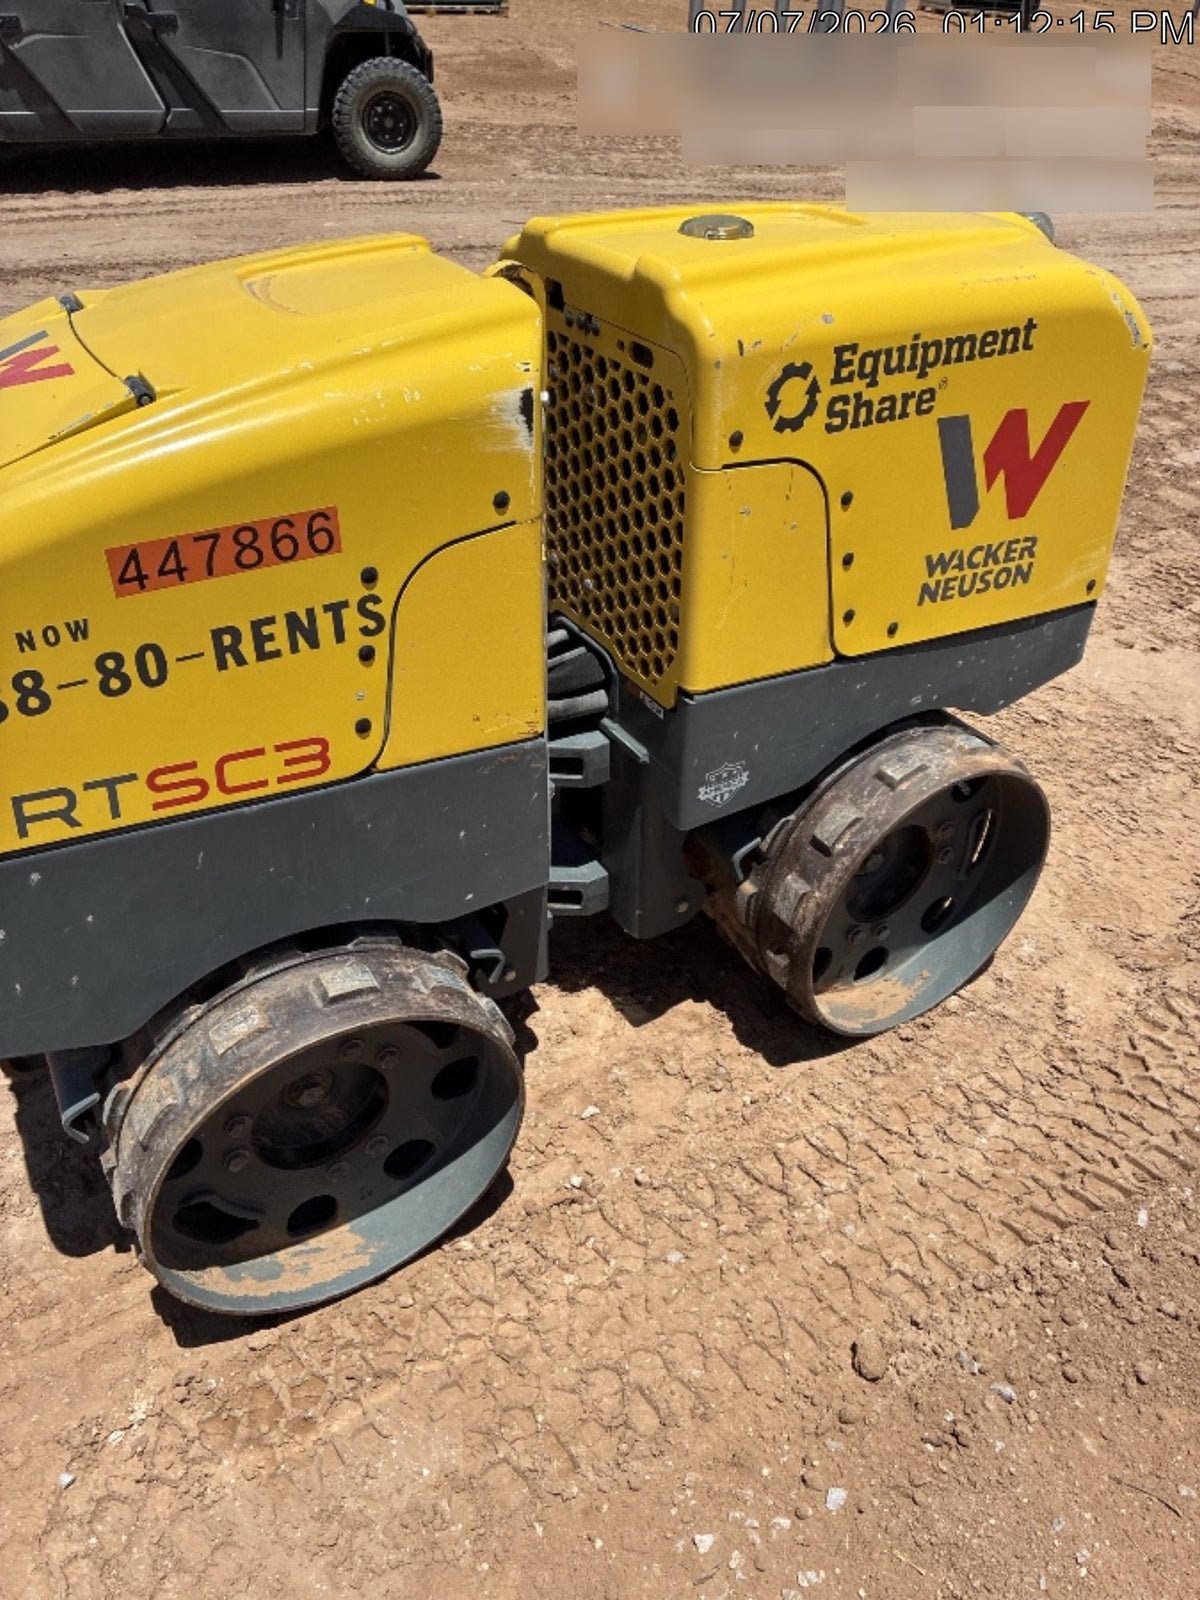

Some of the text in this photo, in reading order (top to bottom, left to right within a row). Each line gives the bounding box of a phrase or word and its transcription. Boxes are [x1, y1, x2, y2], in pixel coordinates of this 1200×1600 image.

[830, 318, 1037, 388] Equipment
[117, 512, 335, 591] 447866
[918, 562, 1033, 606] NEUSON
[926, 537, 1037, 578] WACKER
[0, 594, 387, 724] 8-80-RENTS
[15, 619, 89, 653] NOW
[11, 738, 331, 839] RTSC3
